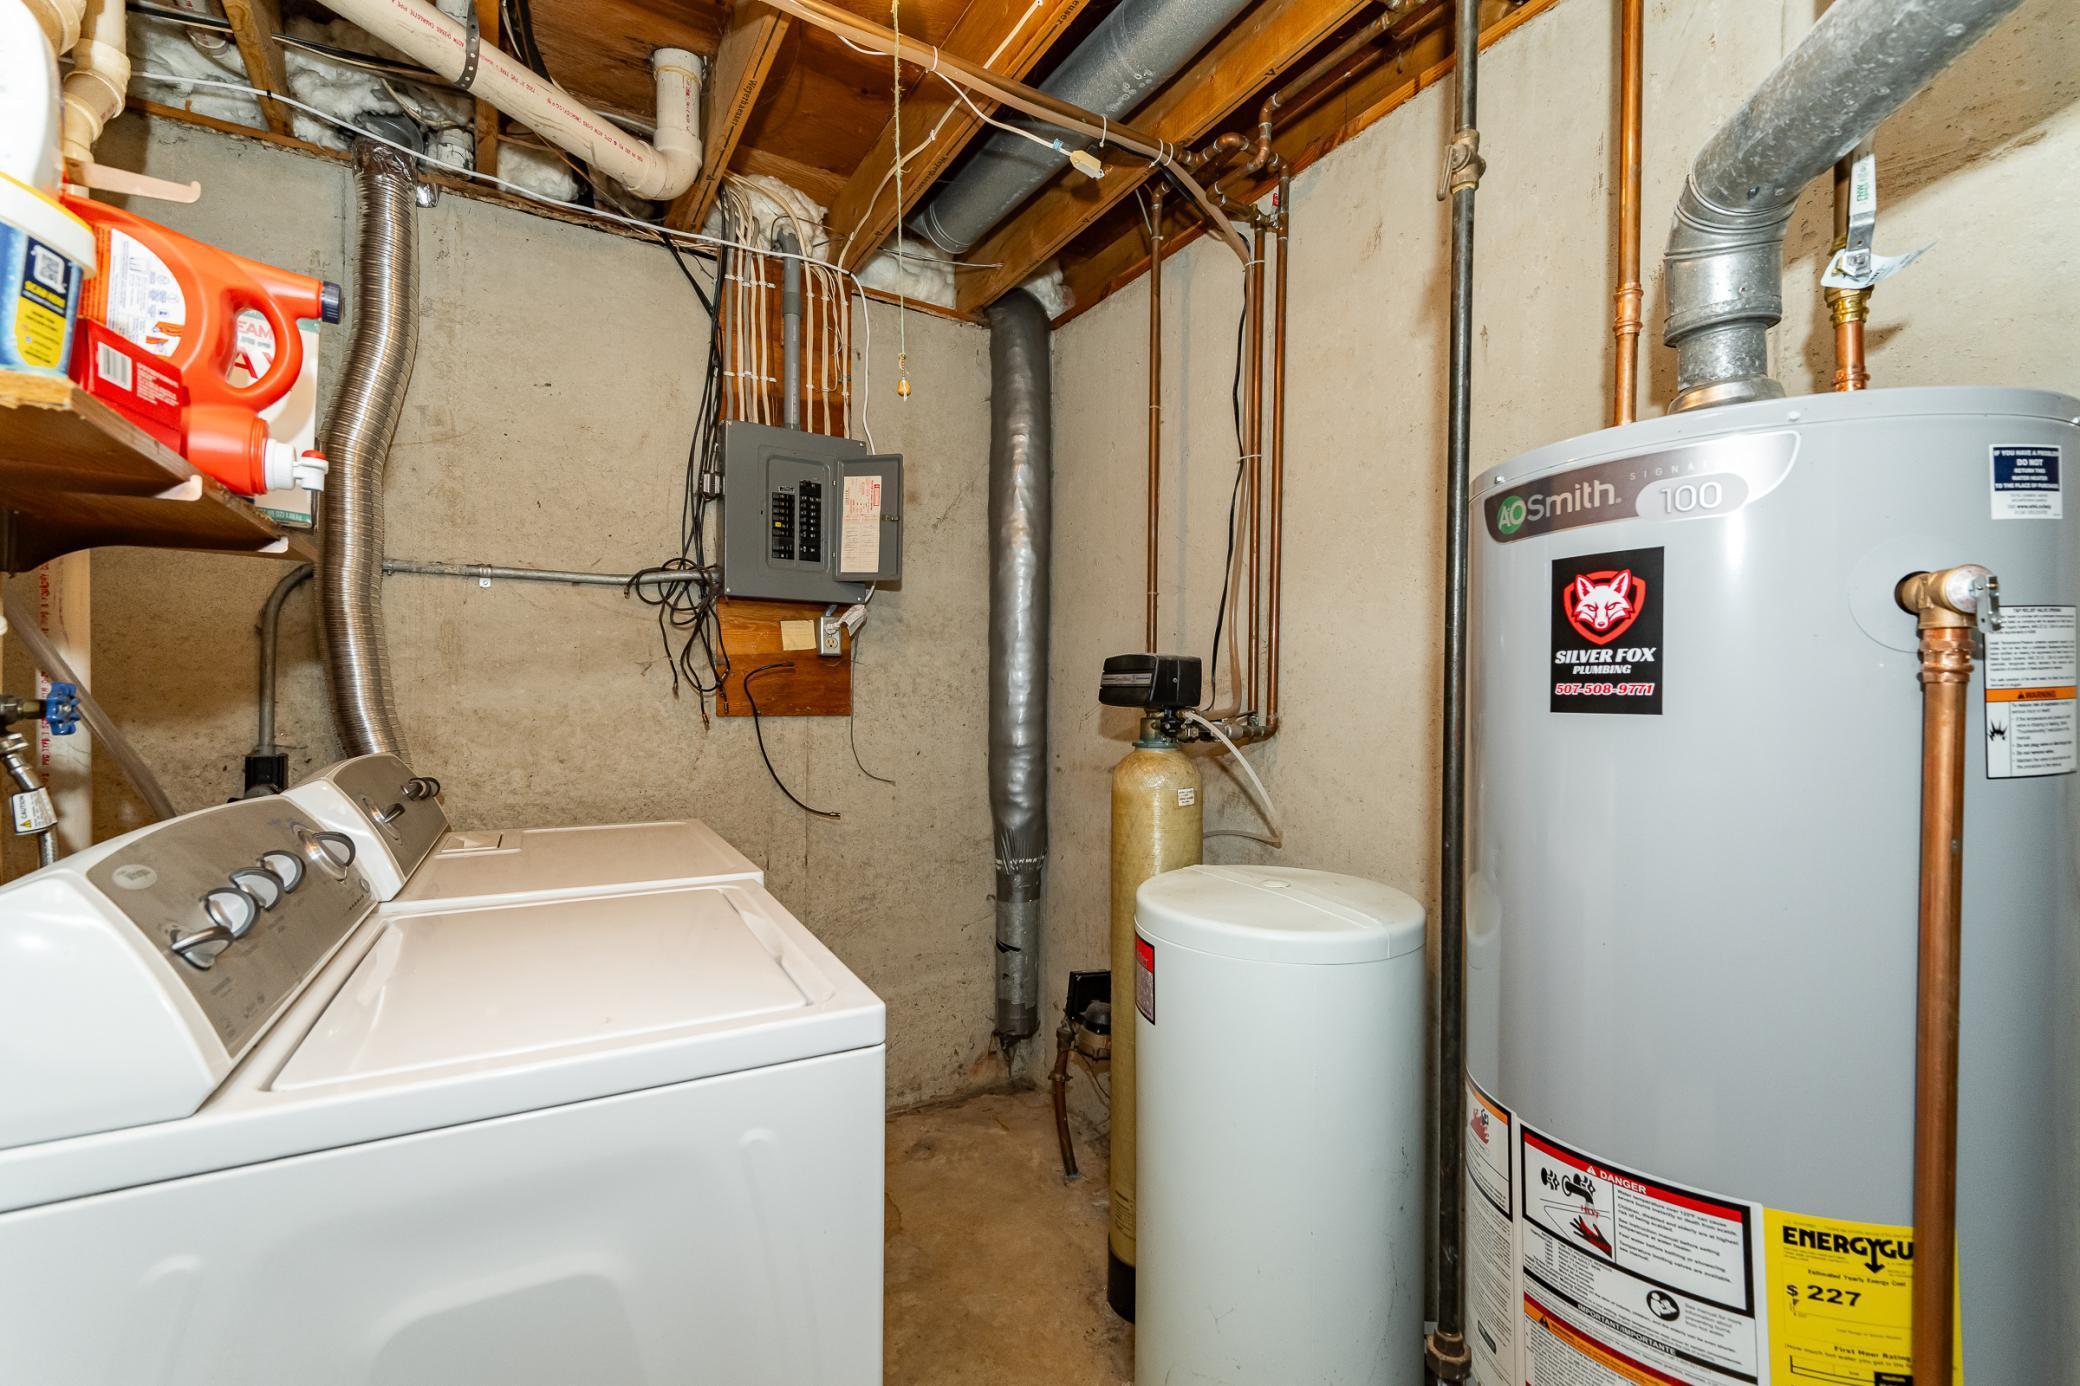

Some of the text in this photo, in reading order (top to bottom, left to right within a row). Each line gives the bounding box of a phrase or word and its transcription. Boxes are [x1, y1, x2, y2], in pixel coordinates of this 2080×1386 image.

[1660, 481, 1723, 514] 100
[1555, 647, 1657, 664] SILVER FOX
[1572, 664, 1632, 675] PLUMBING
[1555, 682, 1655, 696] 507-508-9771
[1600, 1169, 1647, 1195] DANGER
[1783, 1225, 1914, 1261] ENERGYGU
[1786, 1284, 1862, 1307] $ 227
[1577, 1303, 1677, 1356] IMPORTANT/IMPORTANTE
